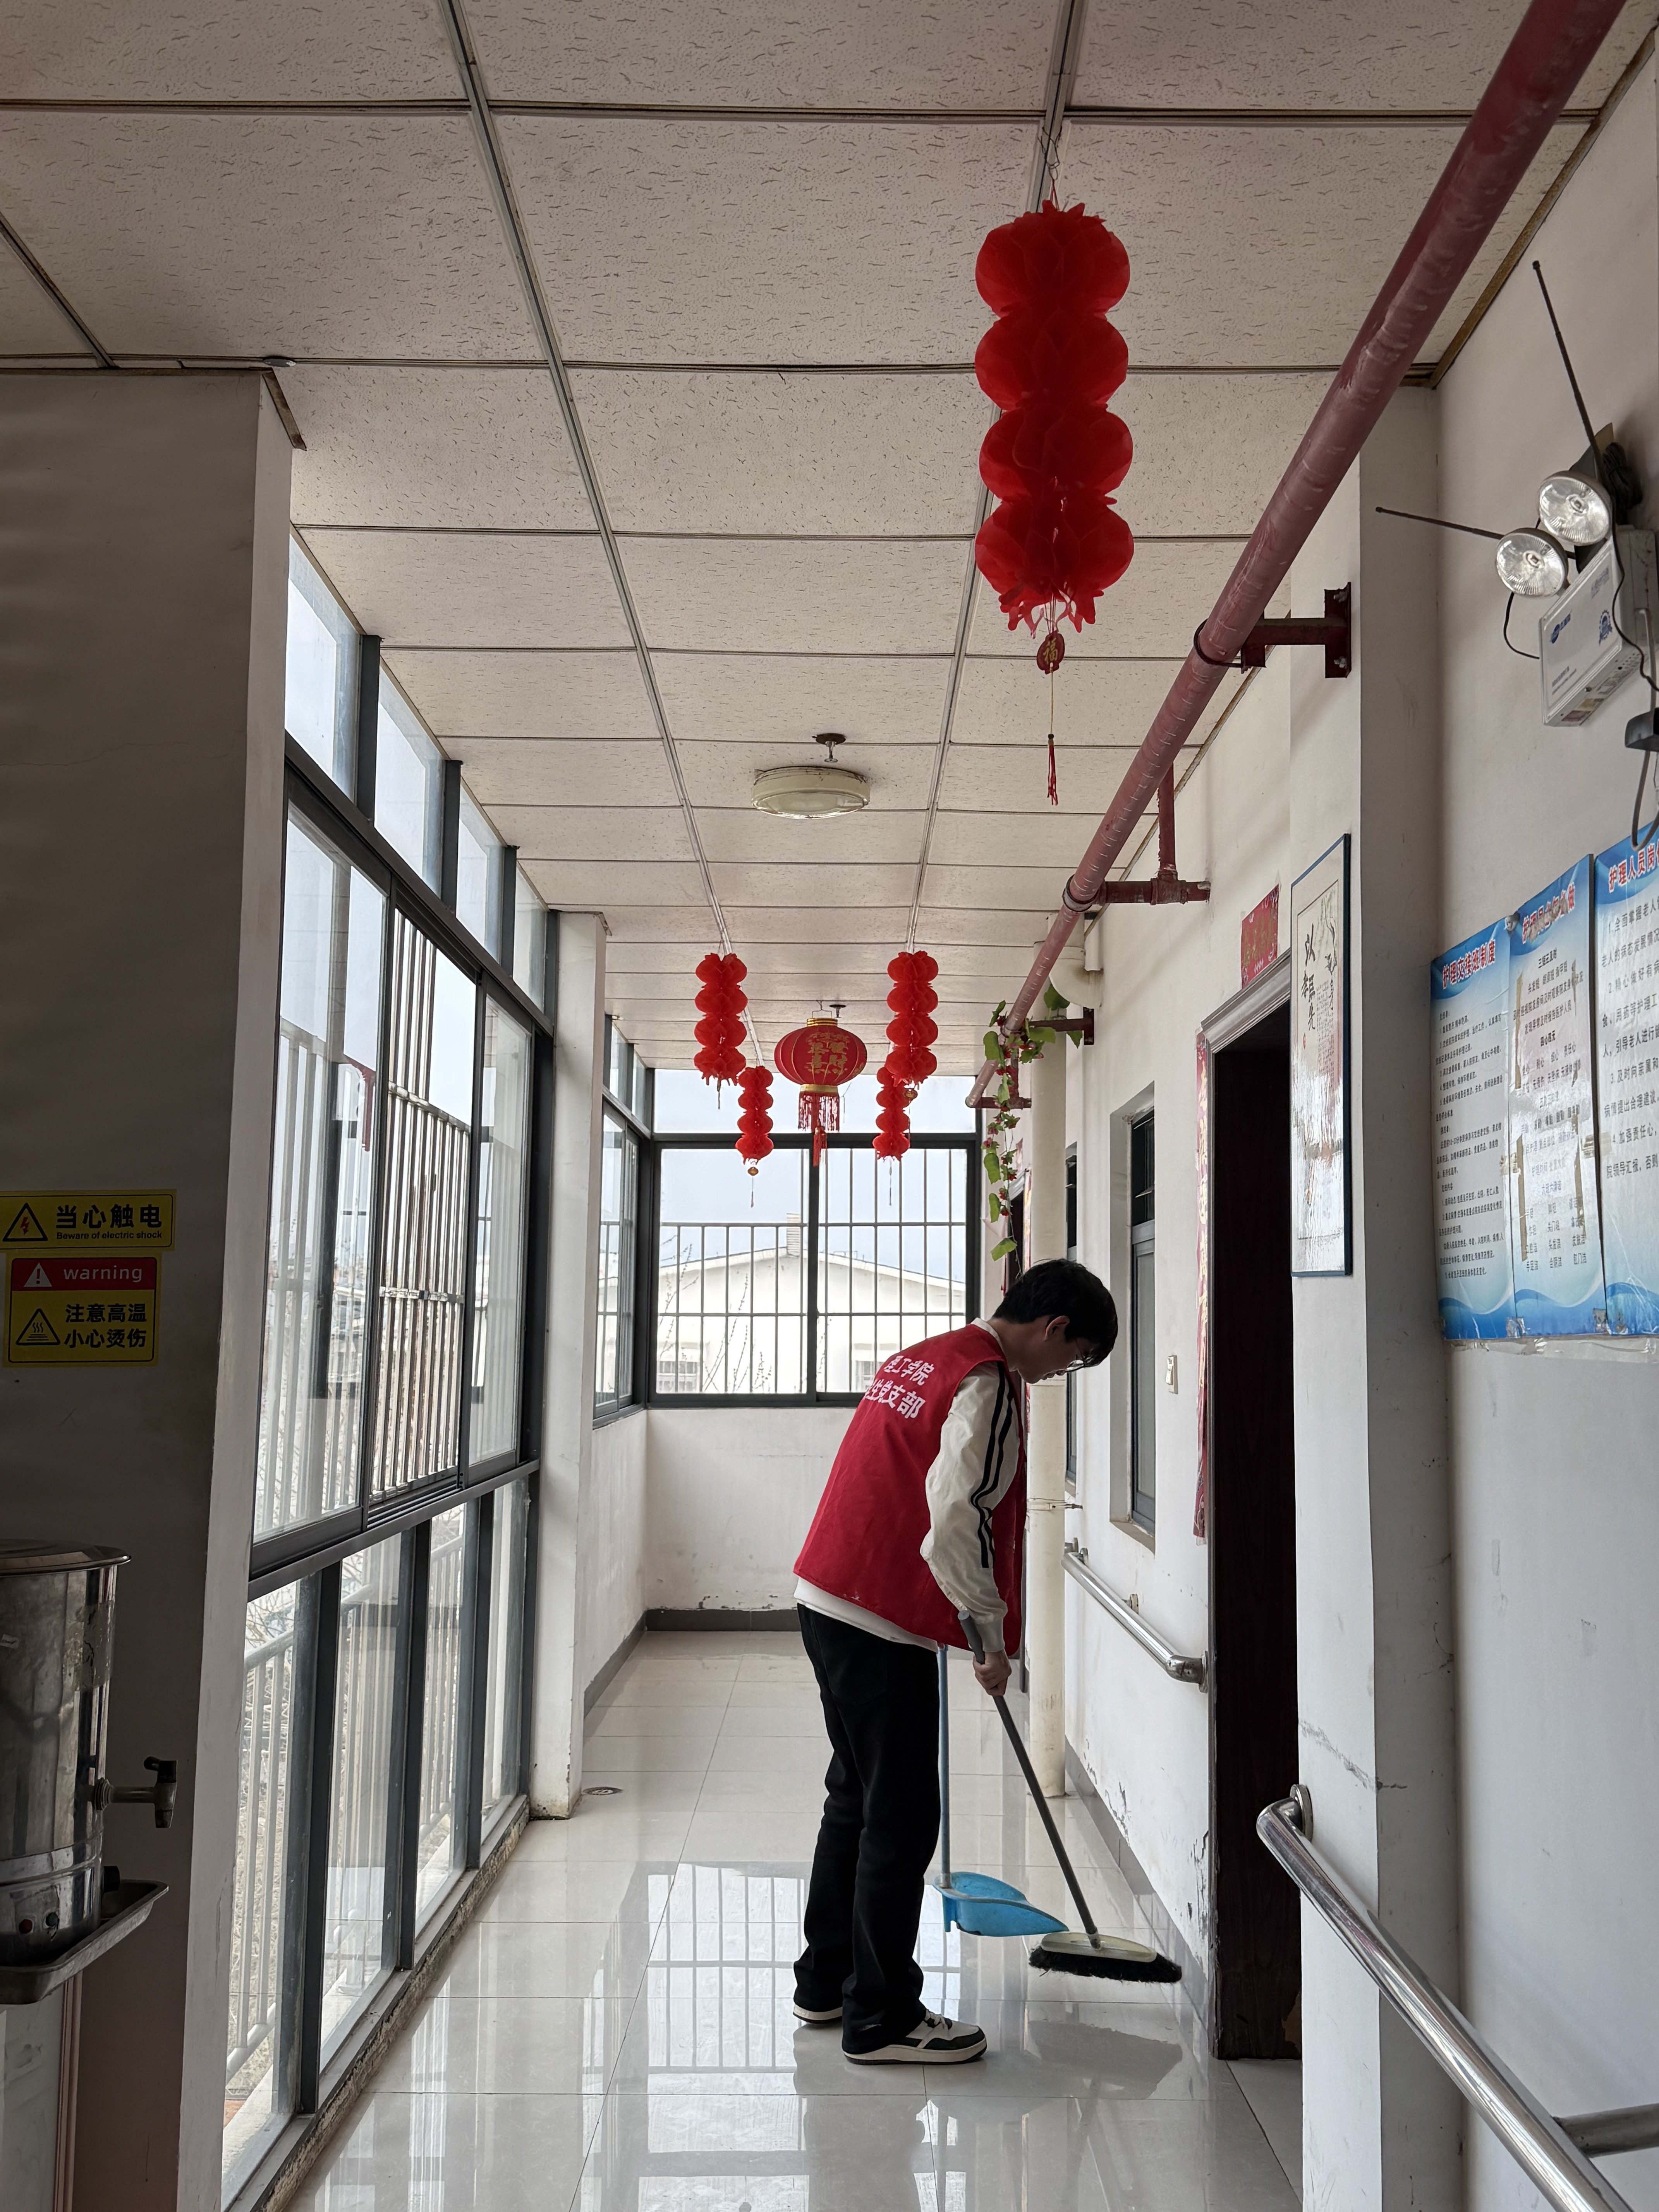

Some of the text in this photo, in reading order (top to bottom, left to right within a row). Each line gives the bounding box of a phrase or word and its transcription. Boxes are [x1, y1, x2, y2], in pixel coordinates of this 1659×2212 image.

[1442, 939, 1496, 989] 护理交接班制度
[56, 1204, 162, 1229] 当心触电
[64, 1265, 143, 1283] warning
[65, 1303, 147, 1323] 注意高温
[64, 1328, 147, 1348] 小心烫伤
